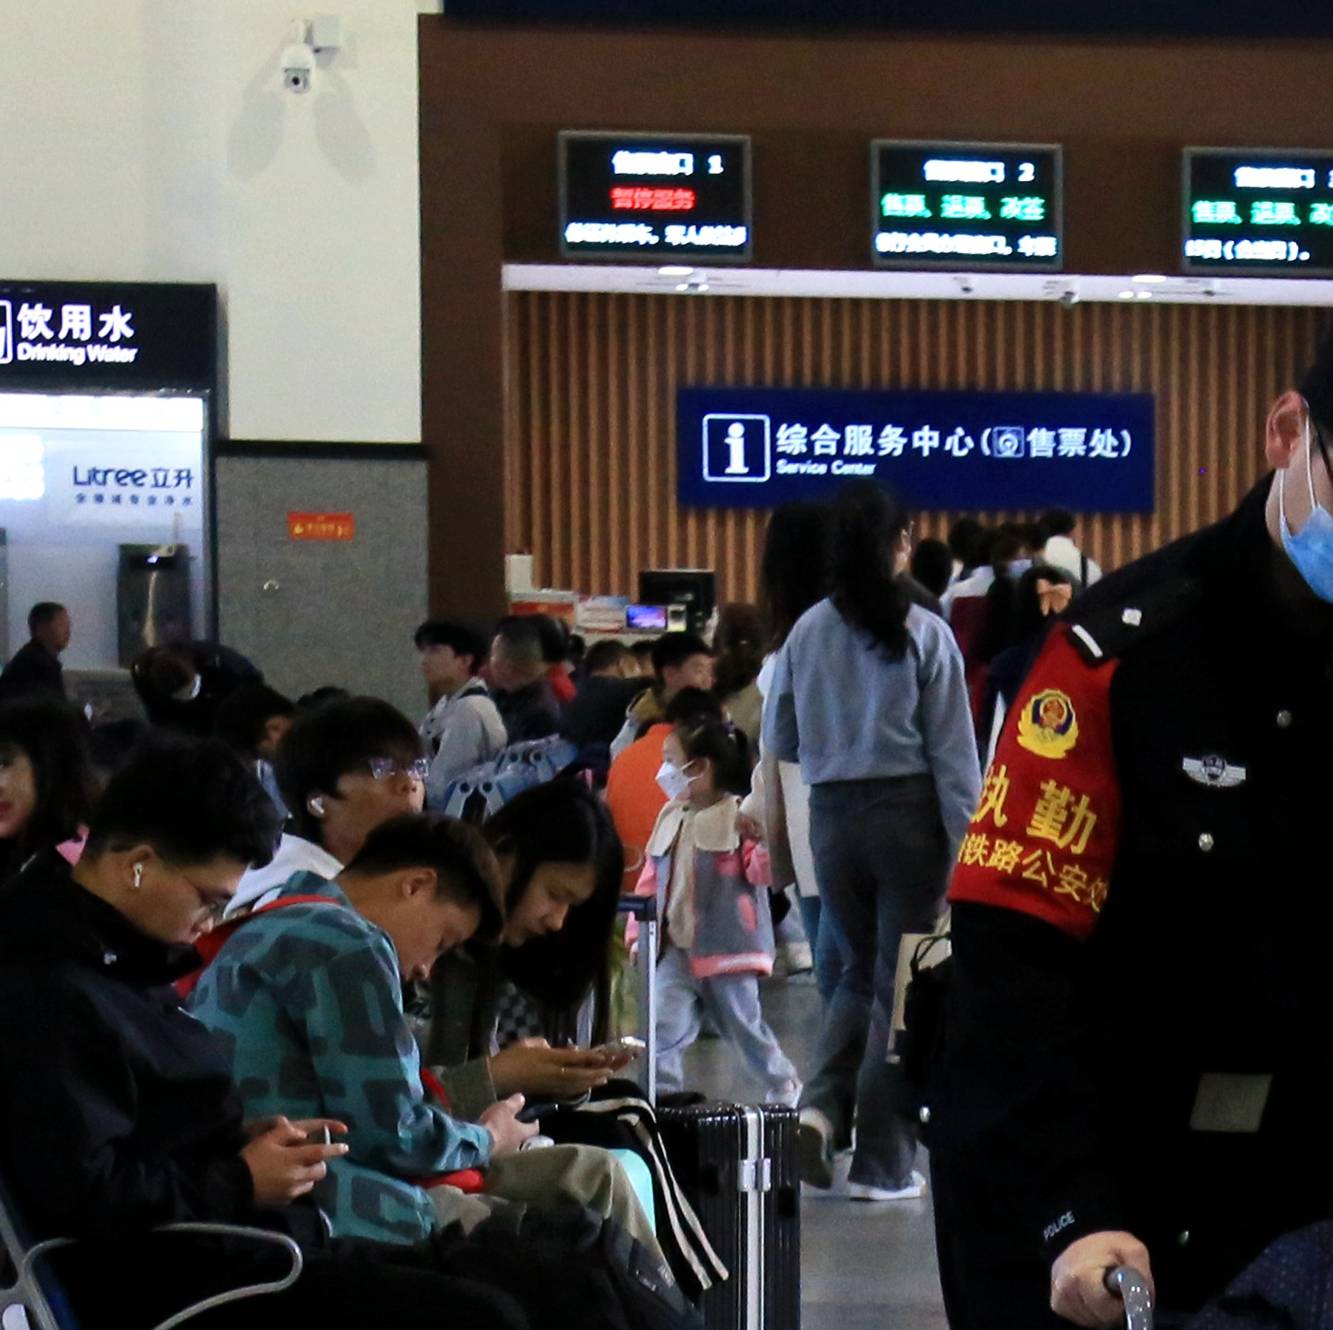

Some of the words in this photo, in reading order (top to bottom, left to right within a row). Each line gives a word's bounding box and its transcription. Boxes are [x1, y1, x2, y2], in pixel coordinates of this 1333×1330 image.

[1017, 163, 1035, 182] 2
[17, 303, 134, 342] 饮用水
[17, 342, 86, 366] Drinking
[87, 344, 138, 363] Water
[73, 464, 147, 487] Litree
[776, 459, 827, 475] Service
[831, 460, 877, 476] Center
